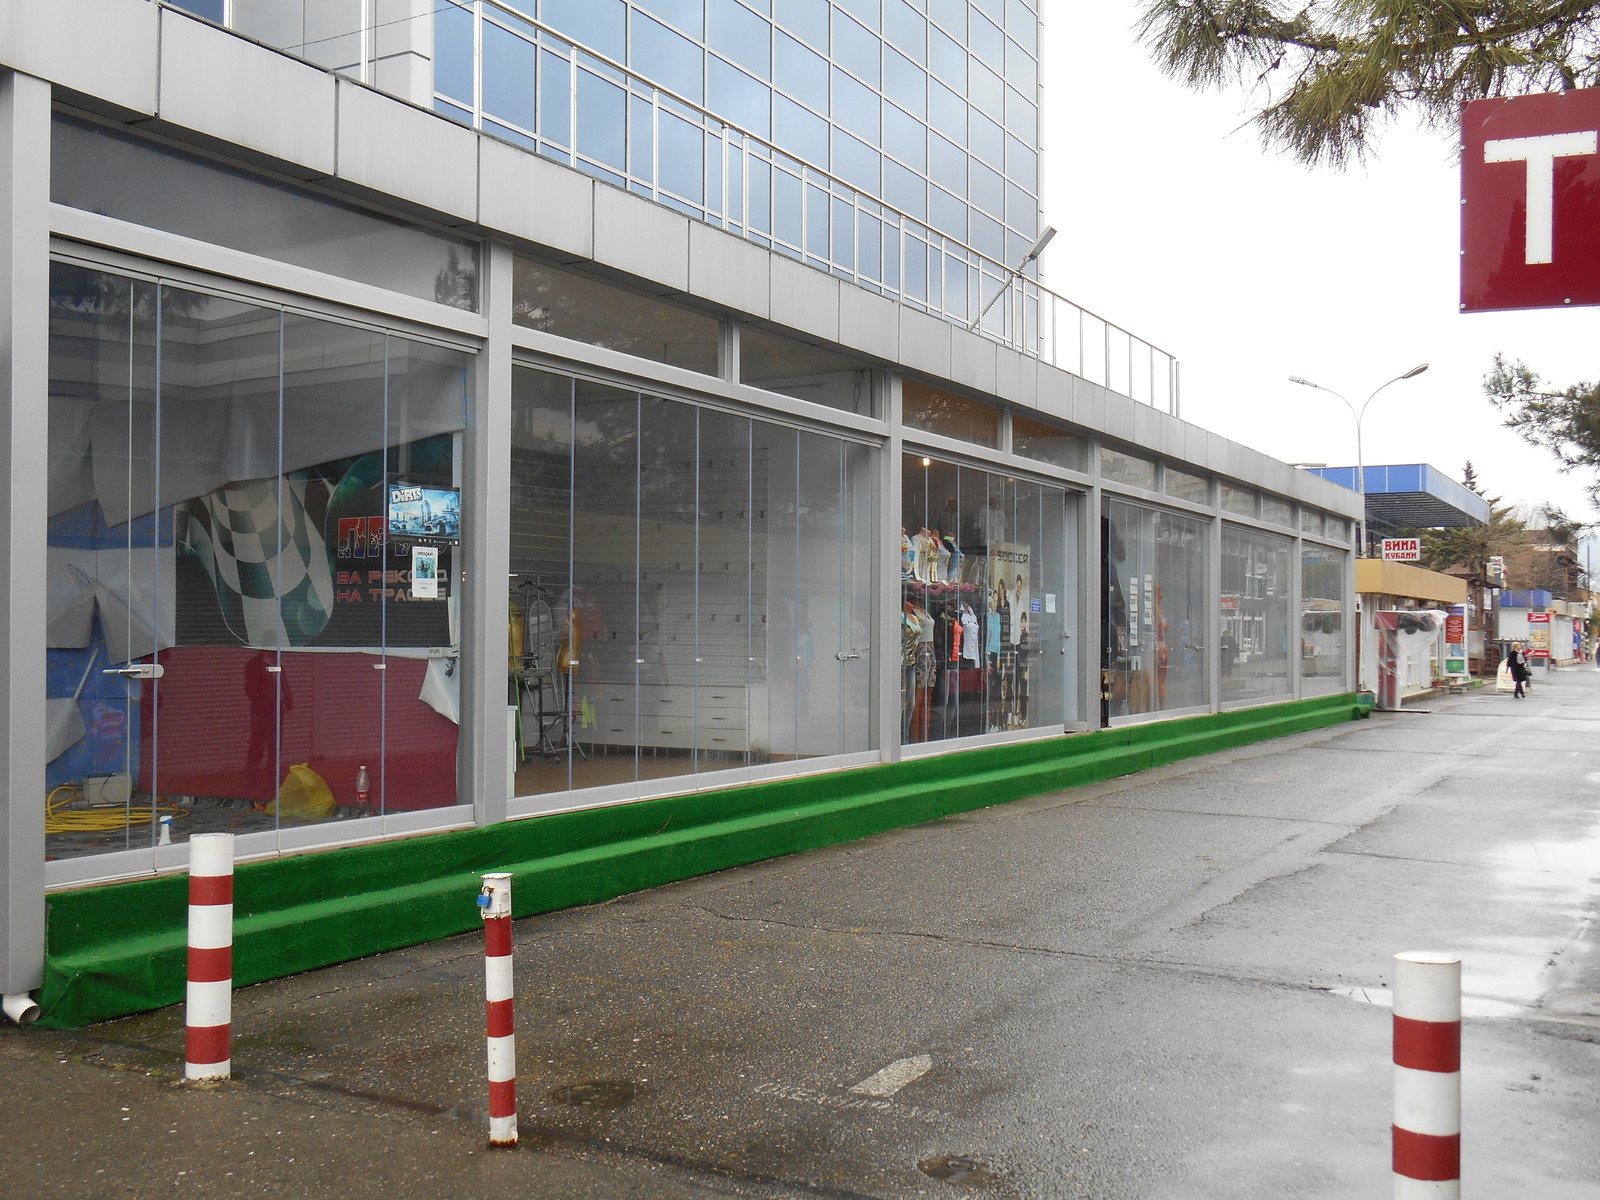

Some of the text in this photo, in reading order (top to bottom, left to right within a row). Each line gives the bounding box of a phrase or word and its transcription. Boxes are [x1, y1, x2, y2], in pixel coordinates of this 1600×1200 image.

[1384, 540, 1417, 551] ВИНА
[337, 569, 448, 585] ЗА РЕКД
[337, 589, 362, 602] НА
